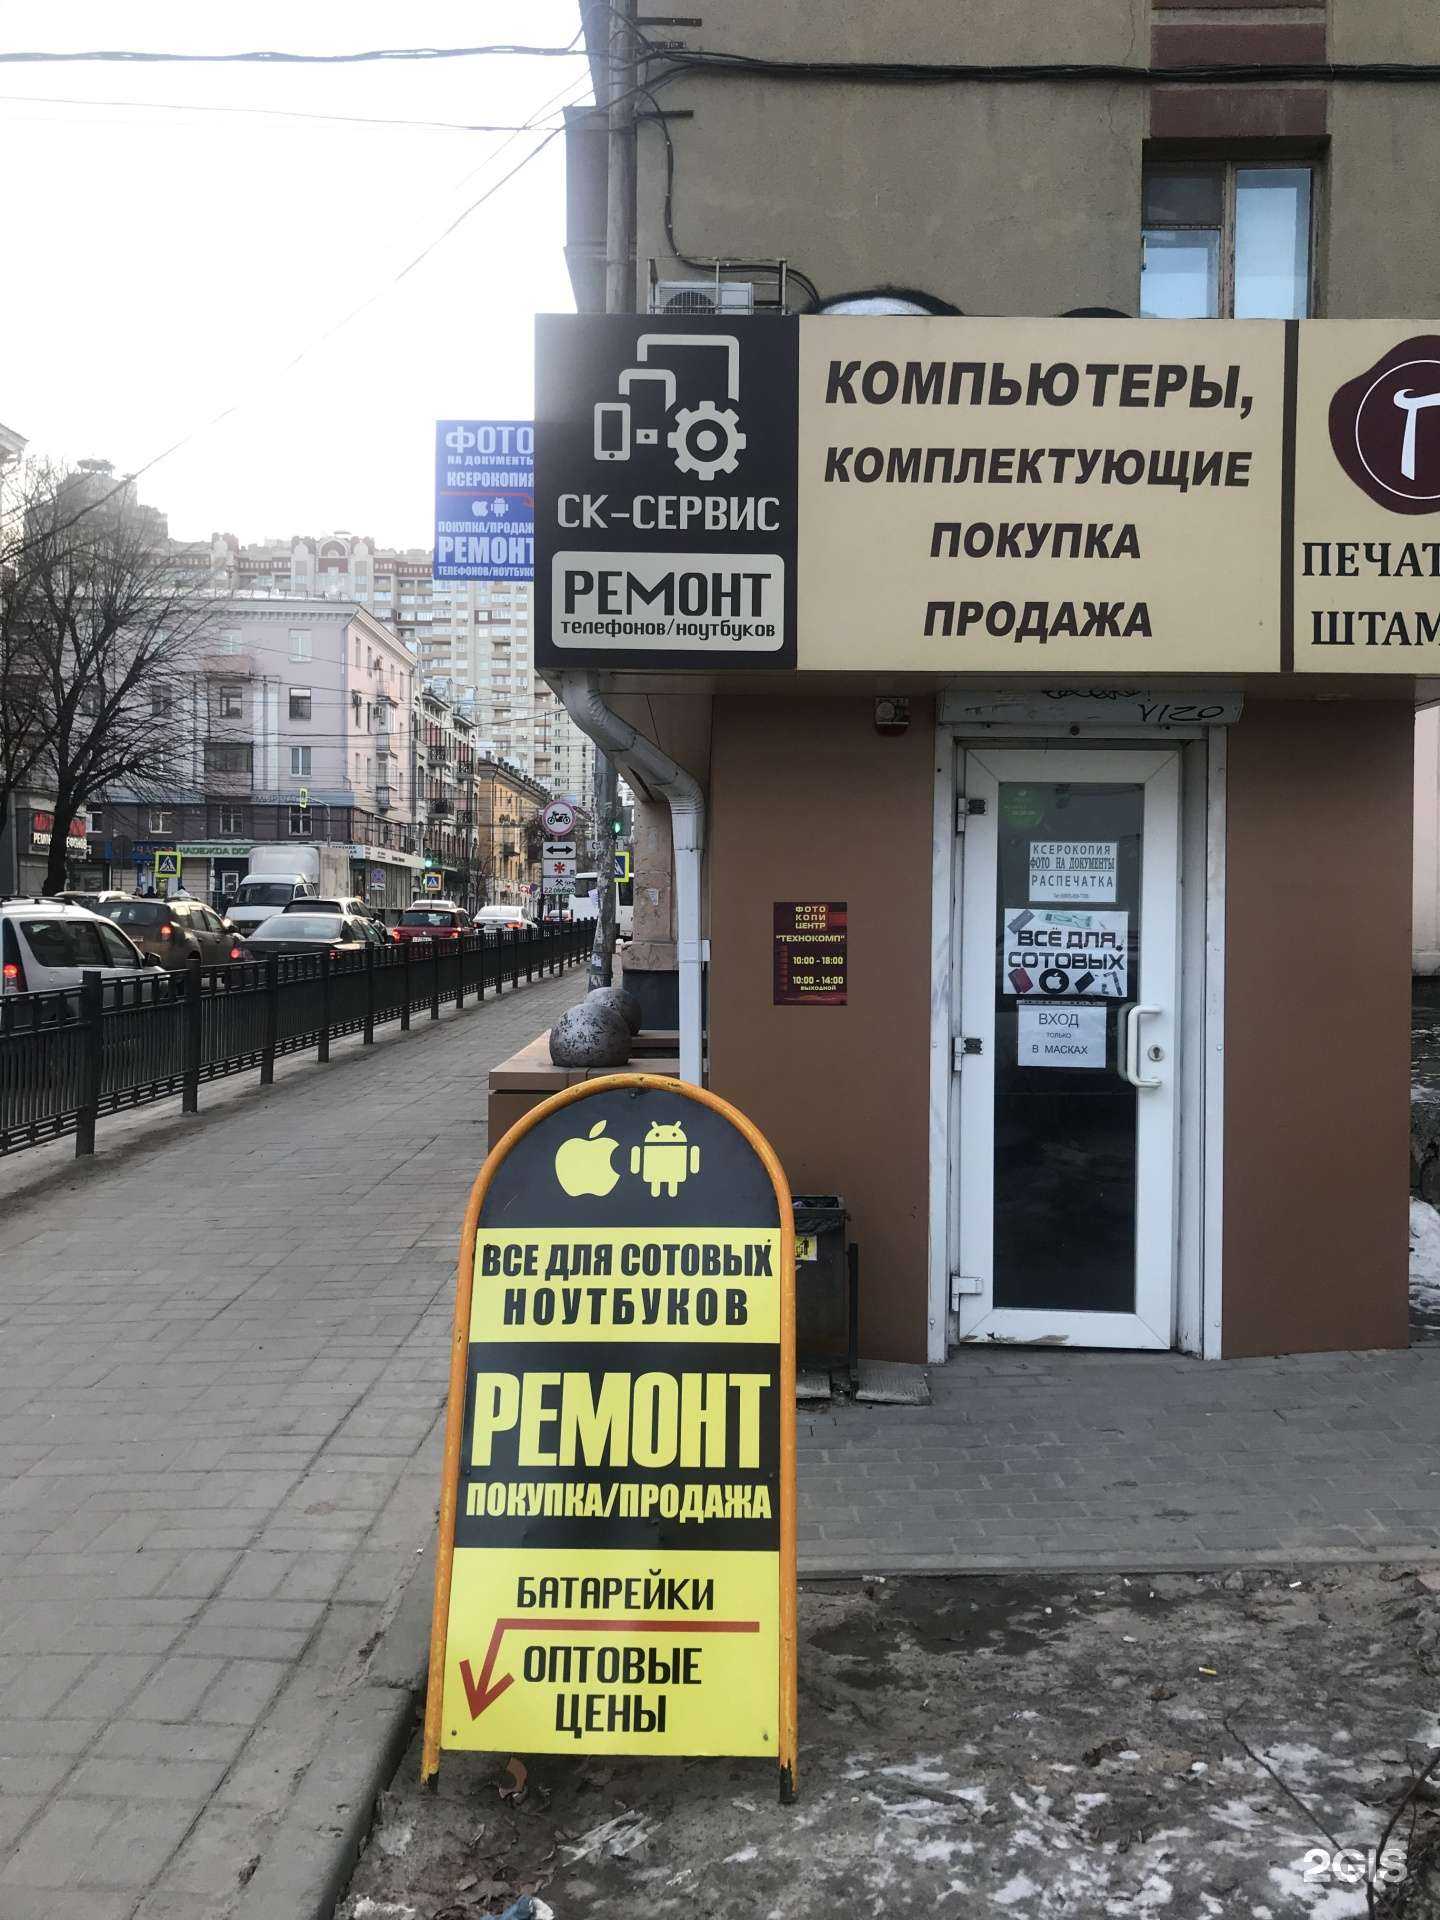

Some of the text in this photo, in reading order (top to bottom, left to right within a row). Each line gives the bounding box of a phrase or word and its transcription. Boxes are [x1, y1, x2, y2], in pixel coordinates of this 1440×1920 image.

[825, 360, 1253, 420] КОМПЬЮТЕРЫ,
[445, 426, 534, 454] ФОТО
[447, 455, 462, 465] НА
[824, 446, 1253, 493] КОМПЛЕКТУЮЩИЕ
[556, 493, 781, 531] СК-СЕРВИС
[930, 522, 1142, 559] ПОКУПКА
[564, 570, 772, 618] РЕМОНТ
[560, 619, 776, 641] телефонов/ноутбуков
[923, 601, 1153, 645] ПРОДАЖА
[1311, 611, 1440, 646] ШТАМ
[1031, 857, 1115, 870] ФОТО НА ДОКУМЕНТЫ
[1033, 844, 1111, 855] КСЕРОКОПИЯ
[1031, 875, 1113, 887] РАСПЕЧАТКА
[795, 922, 826, 930] ЦЕНТР
[1066, 932, 1116, 949] ДЛЯ
[793, 956, 815, 965] 10:00
[1008, 951, 1125, 970] СОТОВЫХ
[793, 976, 815, 985] 10:00
[1038, 1013, 1079, 1028] ВХОД
[1032, 1045, 1088, 1055] В МАСКАХ
[482, 1244, 773, 1281] ВСЕ ДЛЯ СОТОВЫХ
[503, 1287, 748, 1326] НОУТБУКОВ
[471, 1372, 771, 1468] РЕМОНТ
[466, 1482, 772, 1524] ПОКУПКА/ПРОДАЖА
[516, 1568, 715, 1611] БАТАРЕЙКИ
[523, 1645, 702, 1685] ОПТОВЫЕ
[555, 1694, 667, 1739] ЦЕНЫ
